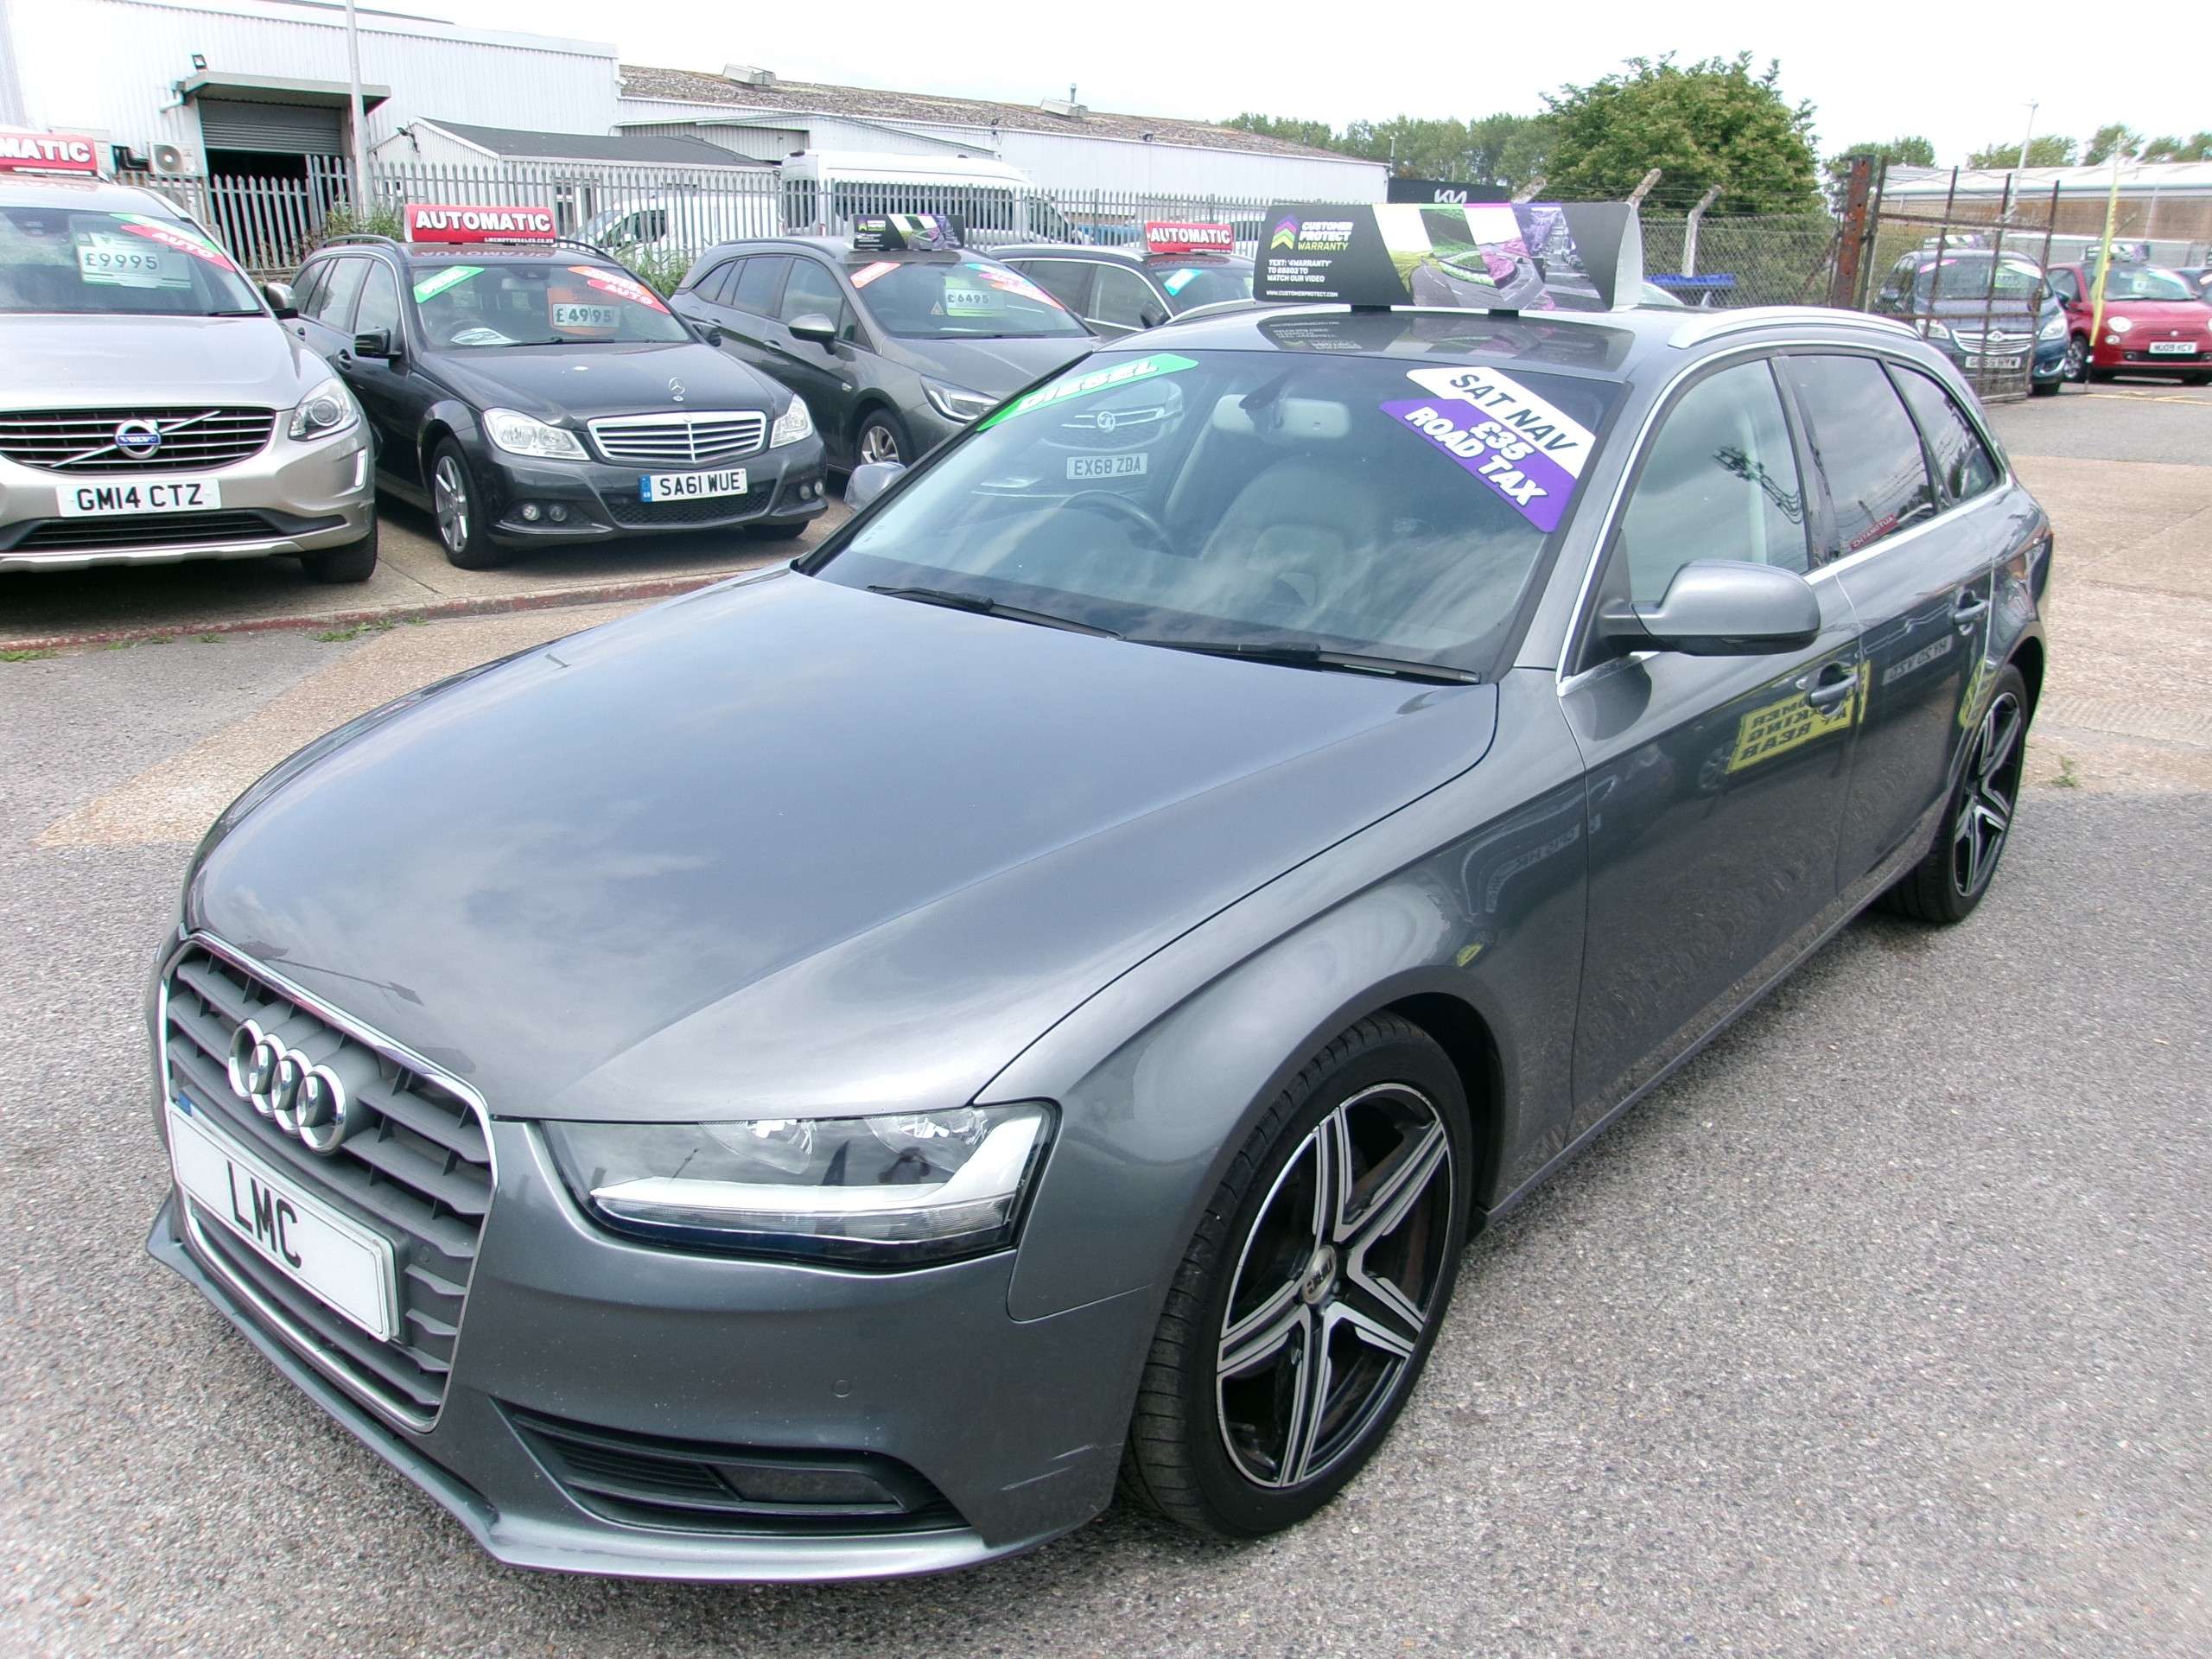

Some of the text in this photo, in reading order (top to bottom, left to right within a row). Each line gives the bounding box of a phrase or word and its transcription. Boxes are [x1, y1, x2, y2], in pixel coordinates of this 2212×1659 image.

[415, 210, 552, 232] AUTOMATIC
[1301, 221, 1353, 232] CUSTOMER
[151, 232, 215, 258] AUTO
[1150, 227, 1231, 245] AUTOMATIC
[1298, 241, 1349, 251] WARRANTY
[1299, 231, 1352, 241] PROTECT
[86, 252, 158, 270] £9995
[605, 283, 654, 306] AUTO
[1450, 374, 1579, 451] SAT NAV
[1470, 421, 1535, 461] £35
[1074, 455, 1141, 476] EX68 ZDA
[1404, 406, 1548, 506] ROAD TAX
[659, 472, 741, 497] SA61 WUE
[77, 483, 204, 512] GM14 CTZ
[226, 1159, 302, 1269] LMC
